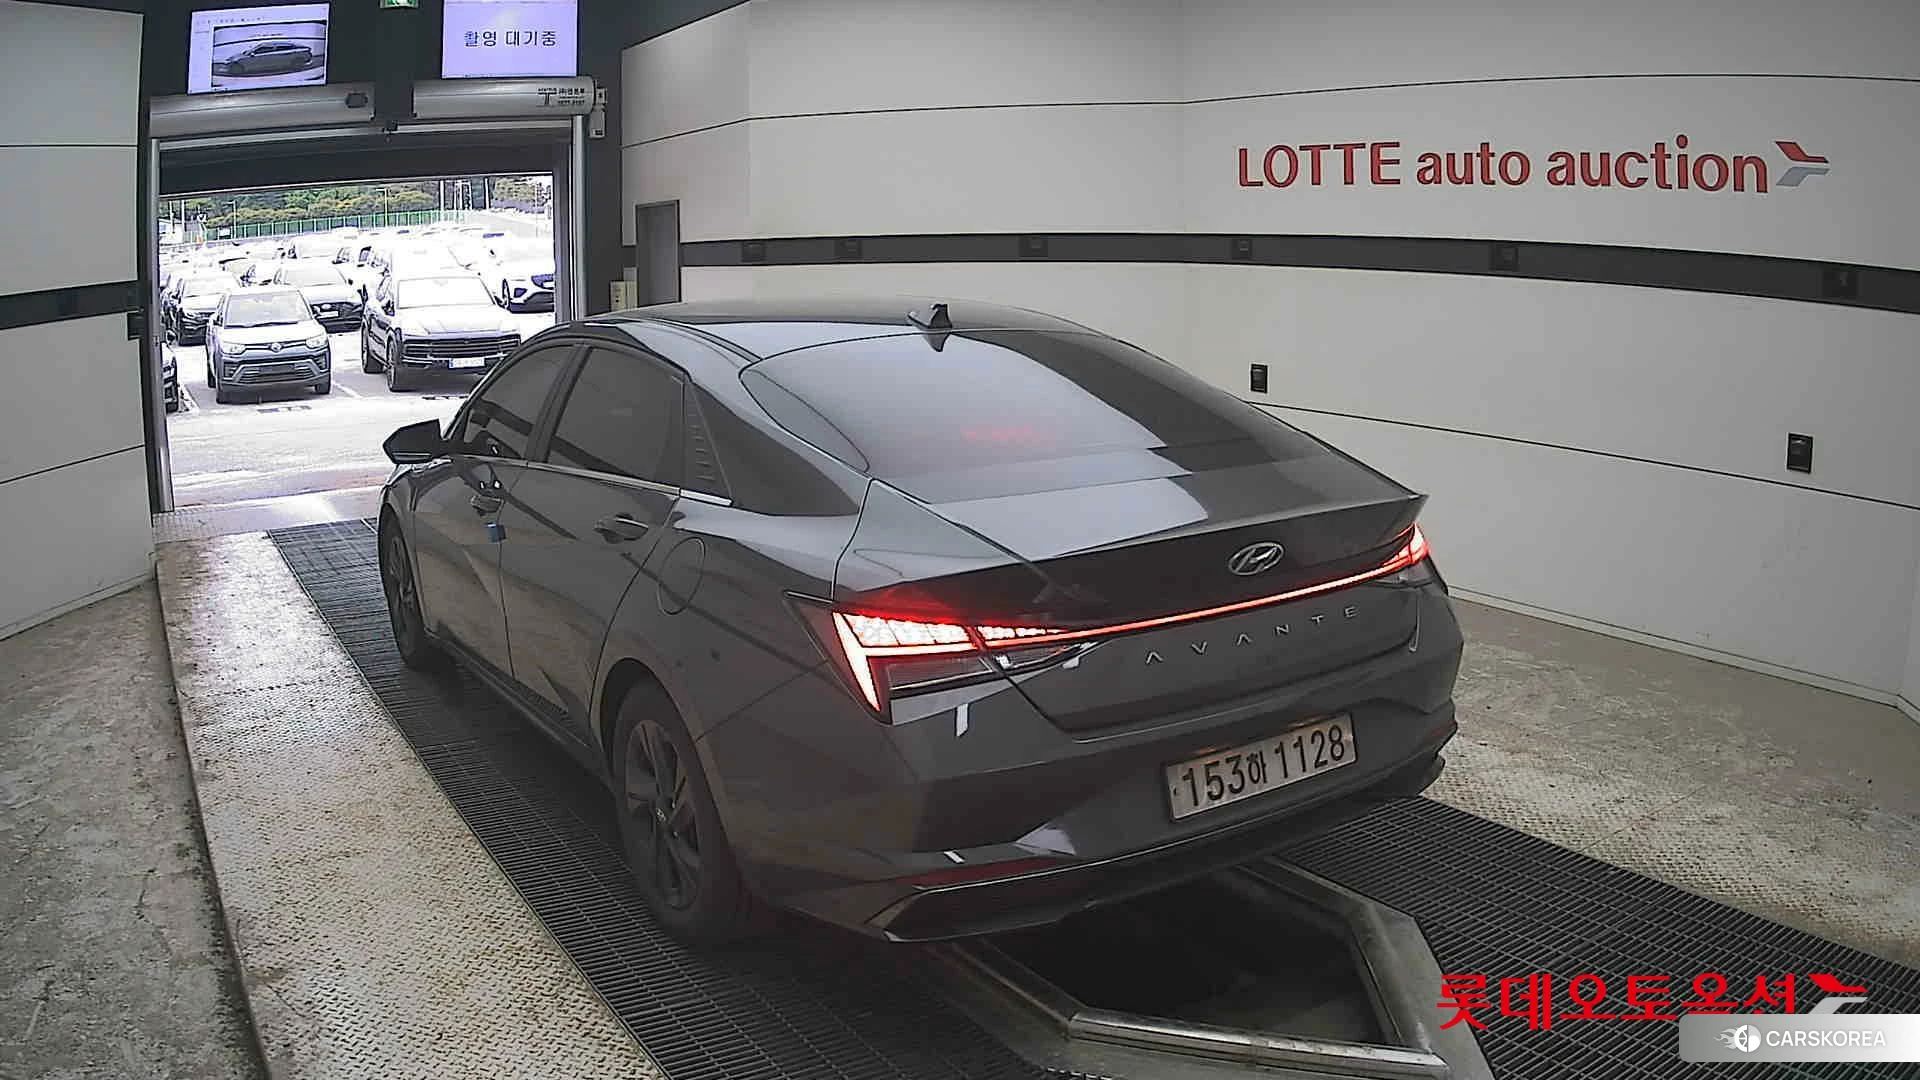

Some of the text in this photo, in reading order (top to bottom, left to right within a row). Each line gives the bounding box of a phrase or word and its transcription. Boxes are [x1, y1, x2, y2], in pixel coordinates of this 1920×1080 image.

[505, 30, 558, 47] 대기중
[1238, 134, 1768, 193] LOTTE auto auction
[1145, 606, 1359, 665] AVANTE
[1182, 724, 1345, 807] 153하 1128
